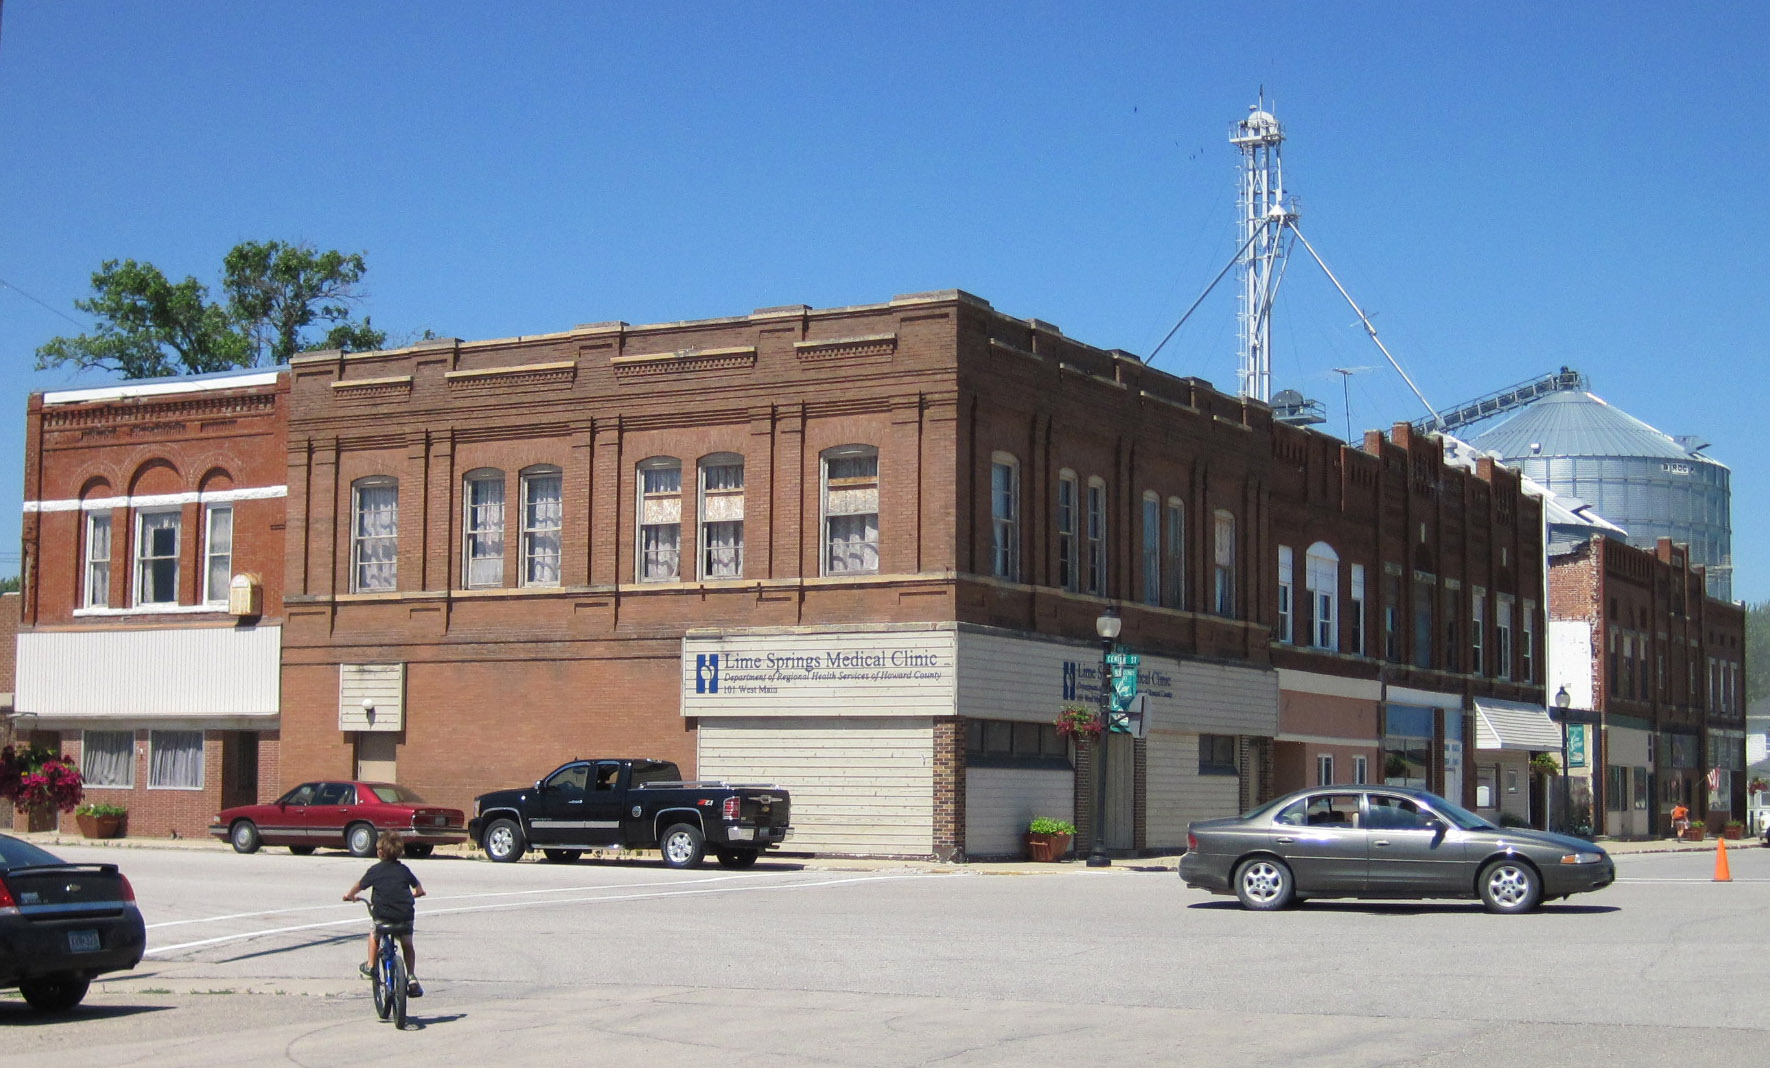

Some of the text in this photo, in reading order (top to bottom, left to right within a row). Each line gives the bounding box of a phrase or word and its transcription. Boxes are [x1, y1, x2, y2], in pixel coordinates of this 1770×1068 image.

[725, 650, 938, 672] Lime Springs Medical Clinic
[724, 671, 941, 683] Department of Regional Health Services of Howard County
[1078, 663, 1096, 679] Lime
[724, 684, 778, 694] 101 West Main
